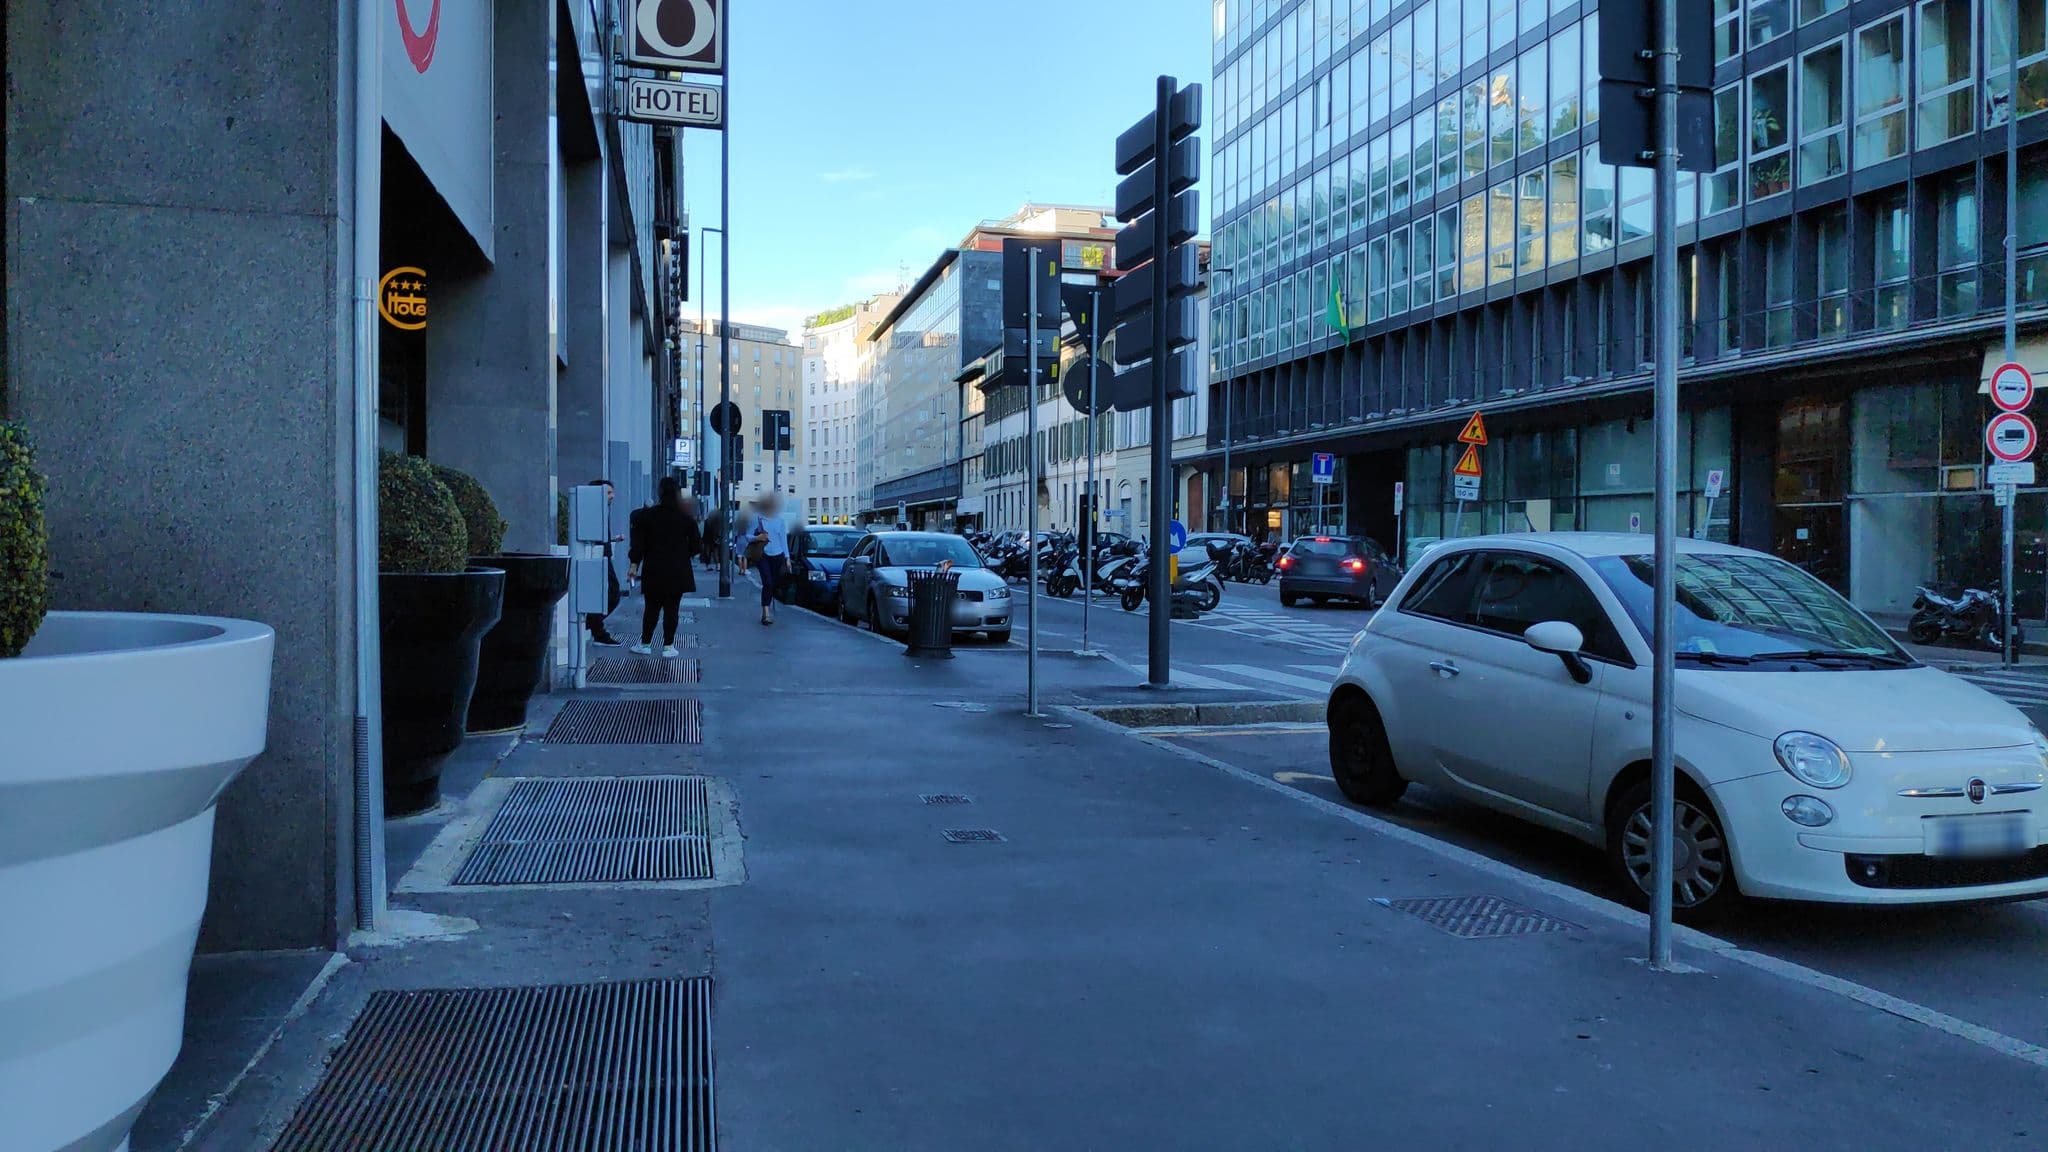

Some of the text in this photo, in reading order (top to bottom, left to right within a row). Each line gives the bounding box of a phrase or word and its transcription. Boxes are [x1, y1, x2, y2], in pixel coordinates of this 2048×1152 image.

[635, 86, 715, 115] HOTEL
[387, 292, 426, 316] Hote
[680, 441, 687, 450] P
